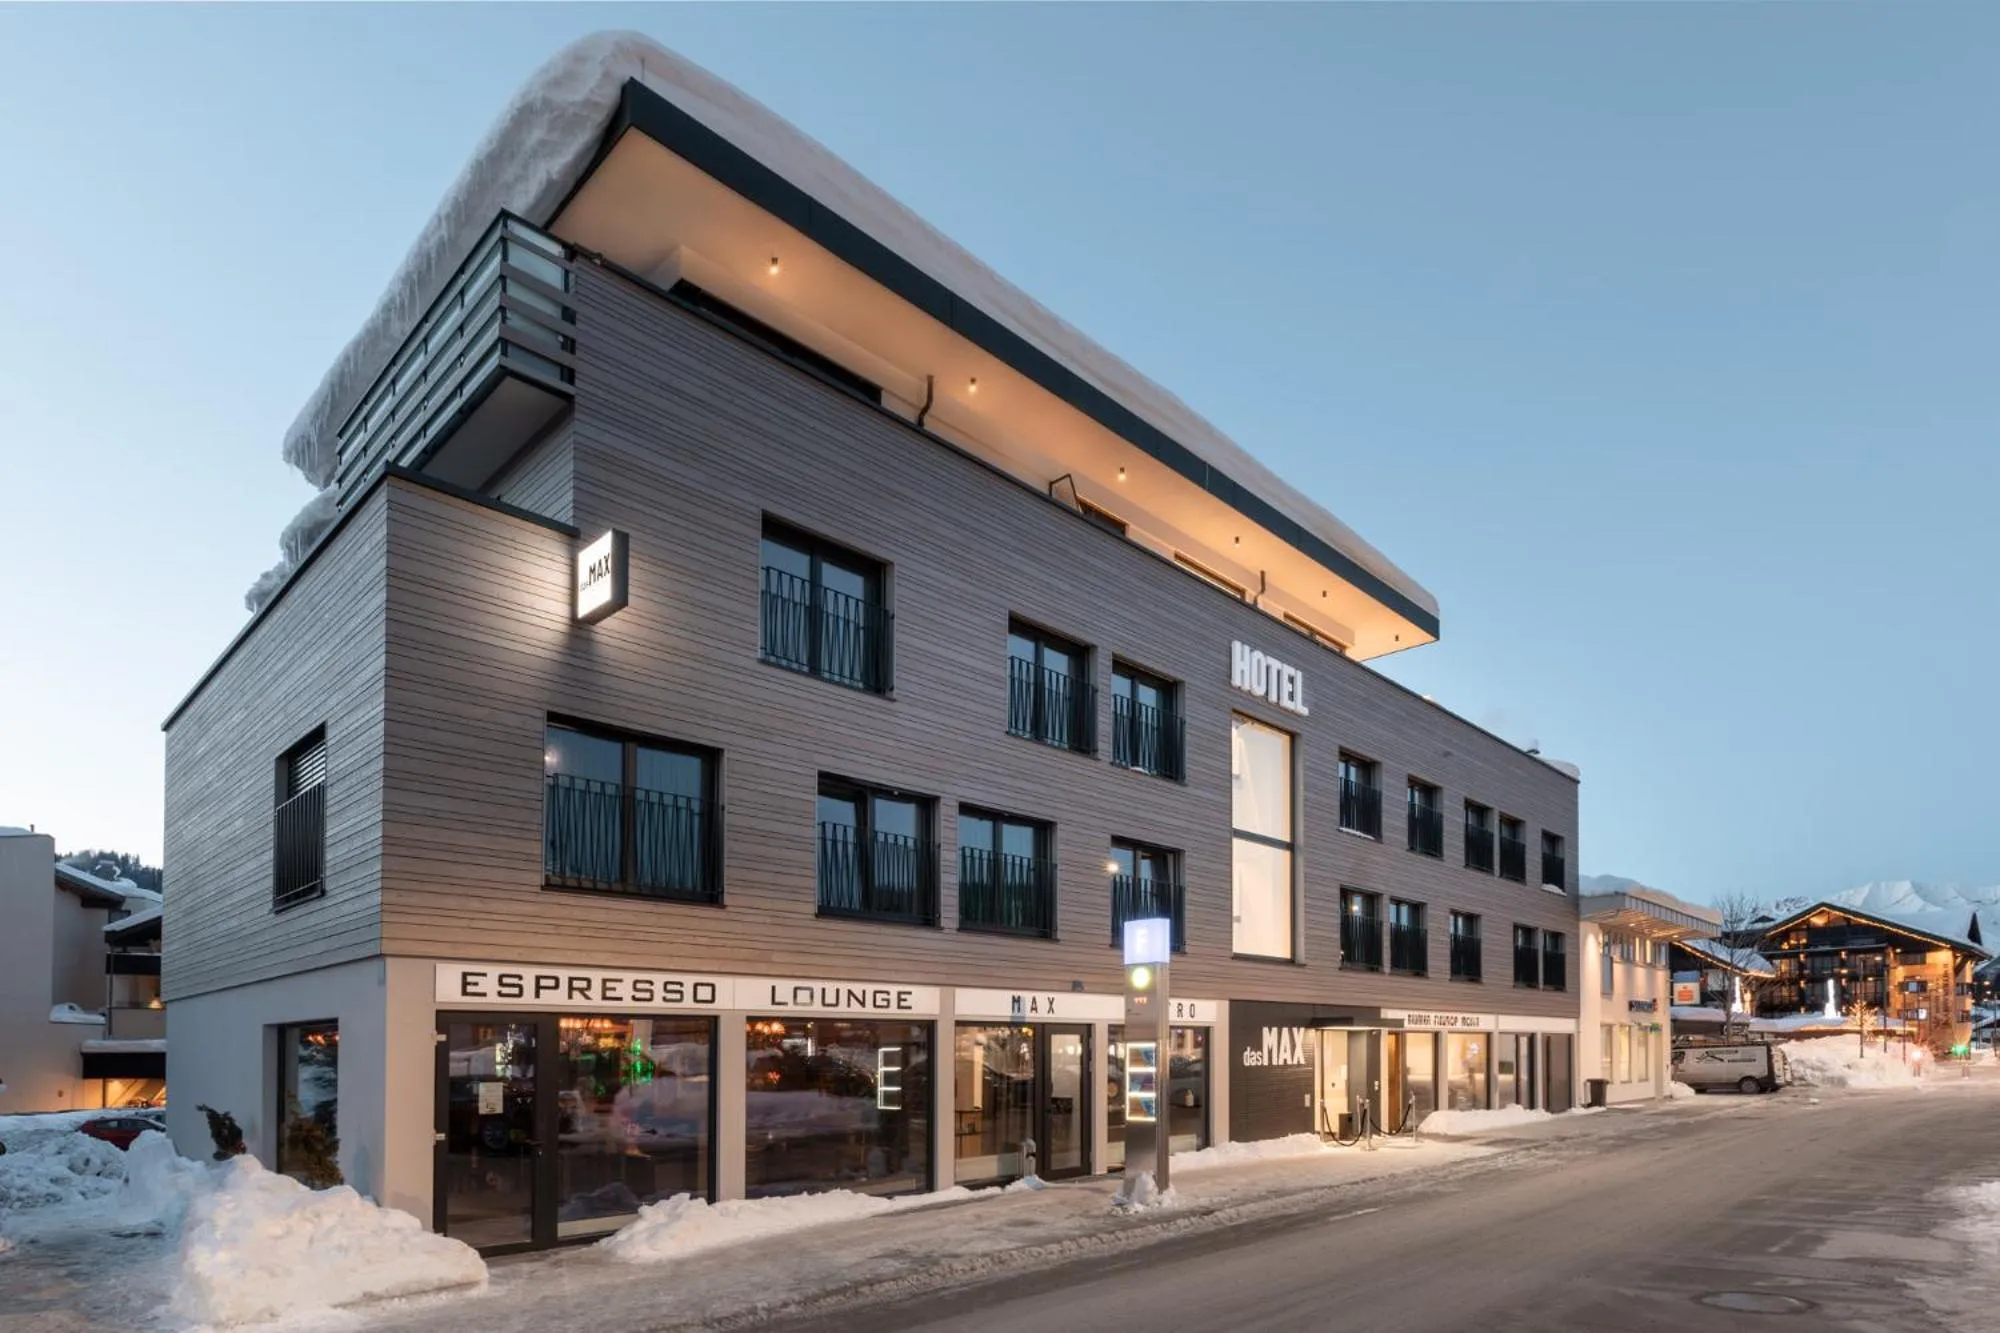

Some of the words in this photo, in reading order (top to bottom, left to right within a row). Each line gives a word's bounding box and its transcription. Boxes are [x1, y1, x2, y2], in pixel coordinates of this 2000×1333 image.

[1231, 640, 1309, 717] HOTEL
[461, 971, 716, 1004] ESPRESSO
[771, 985, 913, 1010] LOUNGE
[1011, 995, 1056, 1014] MAX
[1169, 1002, 1196, 1018] RO
[1243, 1026, 1306, 1067] dasMAX
